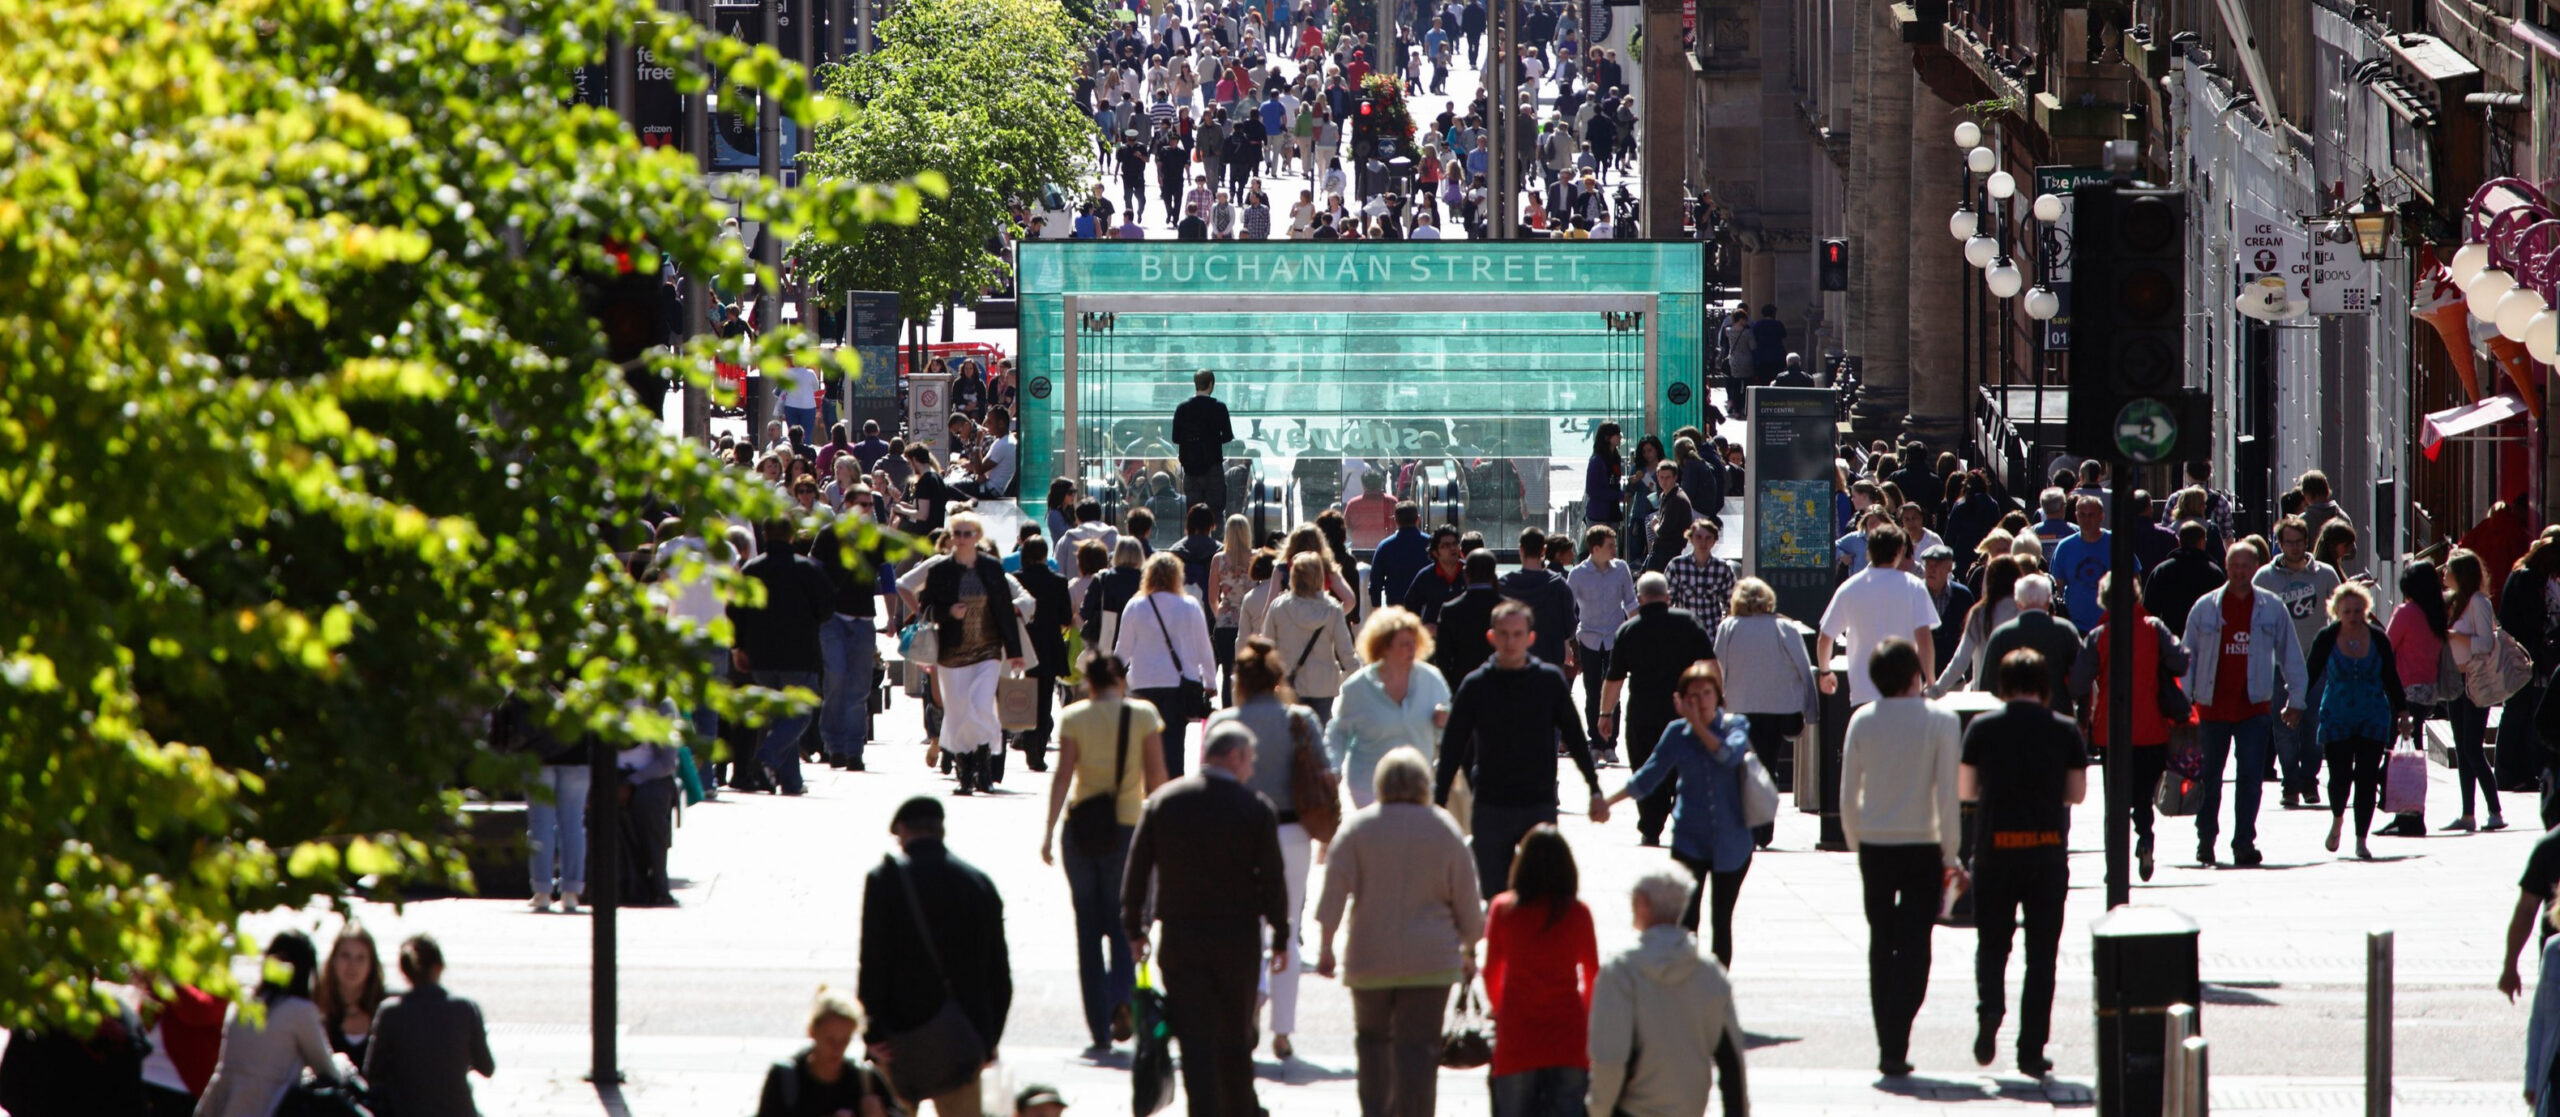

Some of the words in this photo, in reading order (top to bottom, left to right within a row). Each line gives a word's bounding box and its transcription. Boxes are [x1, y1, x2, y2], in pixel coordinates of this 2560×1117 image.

[637, 46, 656, 62] fe
[637, 64, 675, 80] free
[643, 124, 672, 133] citizen
[2255, 224, 2272, 234] ICE
[2245, 237, 2283, 247] CREAM
[2315, 251, 2335, 265] TEA
[1140, 255, 1391, 282] BUCHANAN
[1410, 255, 1586, 282] STREET
[2315, 269, 2351, 284] ROOMS
[2051, 332, 2069, 345] 01
[2293, 599, 2314, 616] 64
[2225, 643, 2249, 655] HSB
